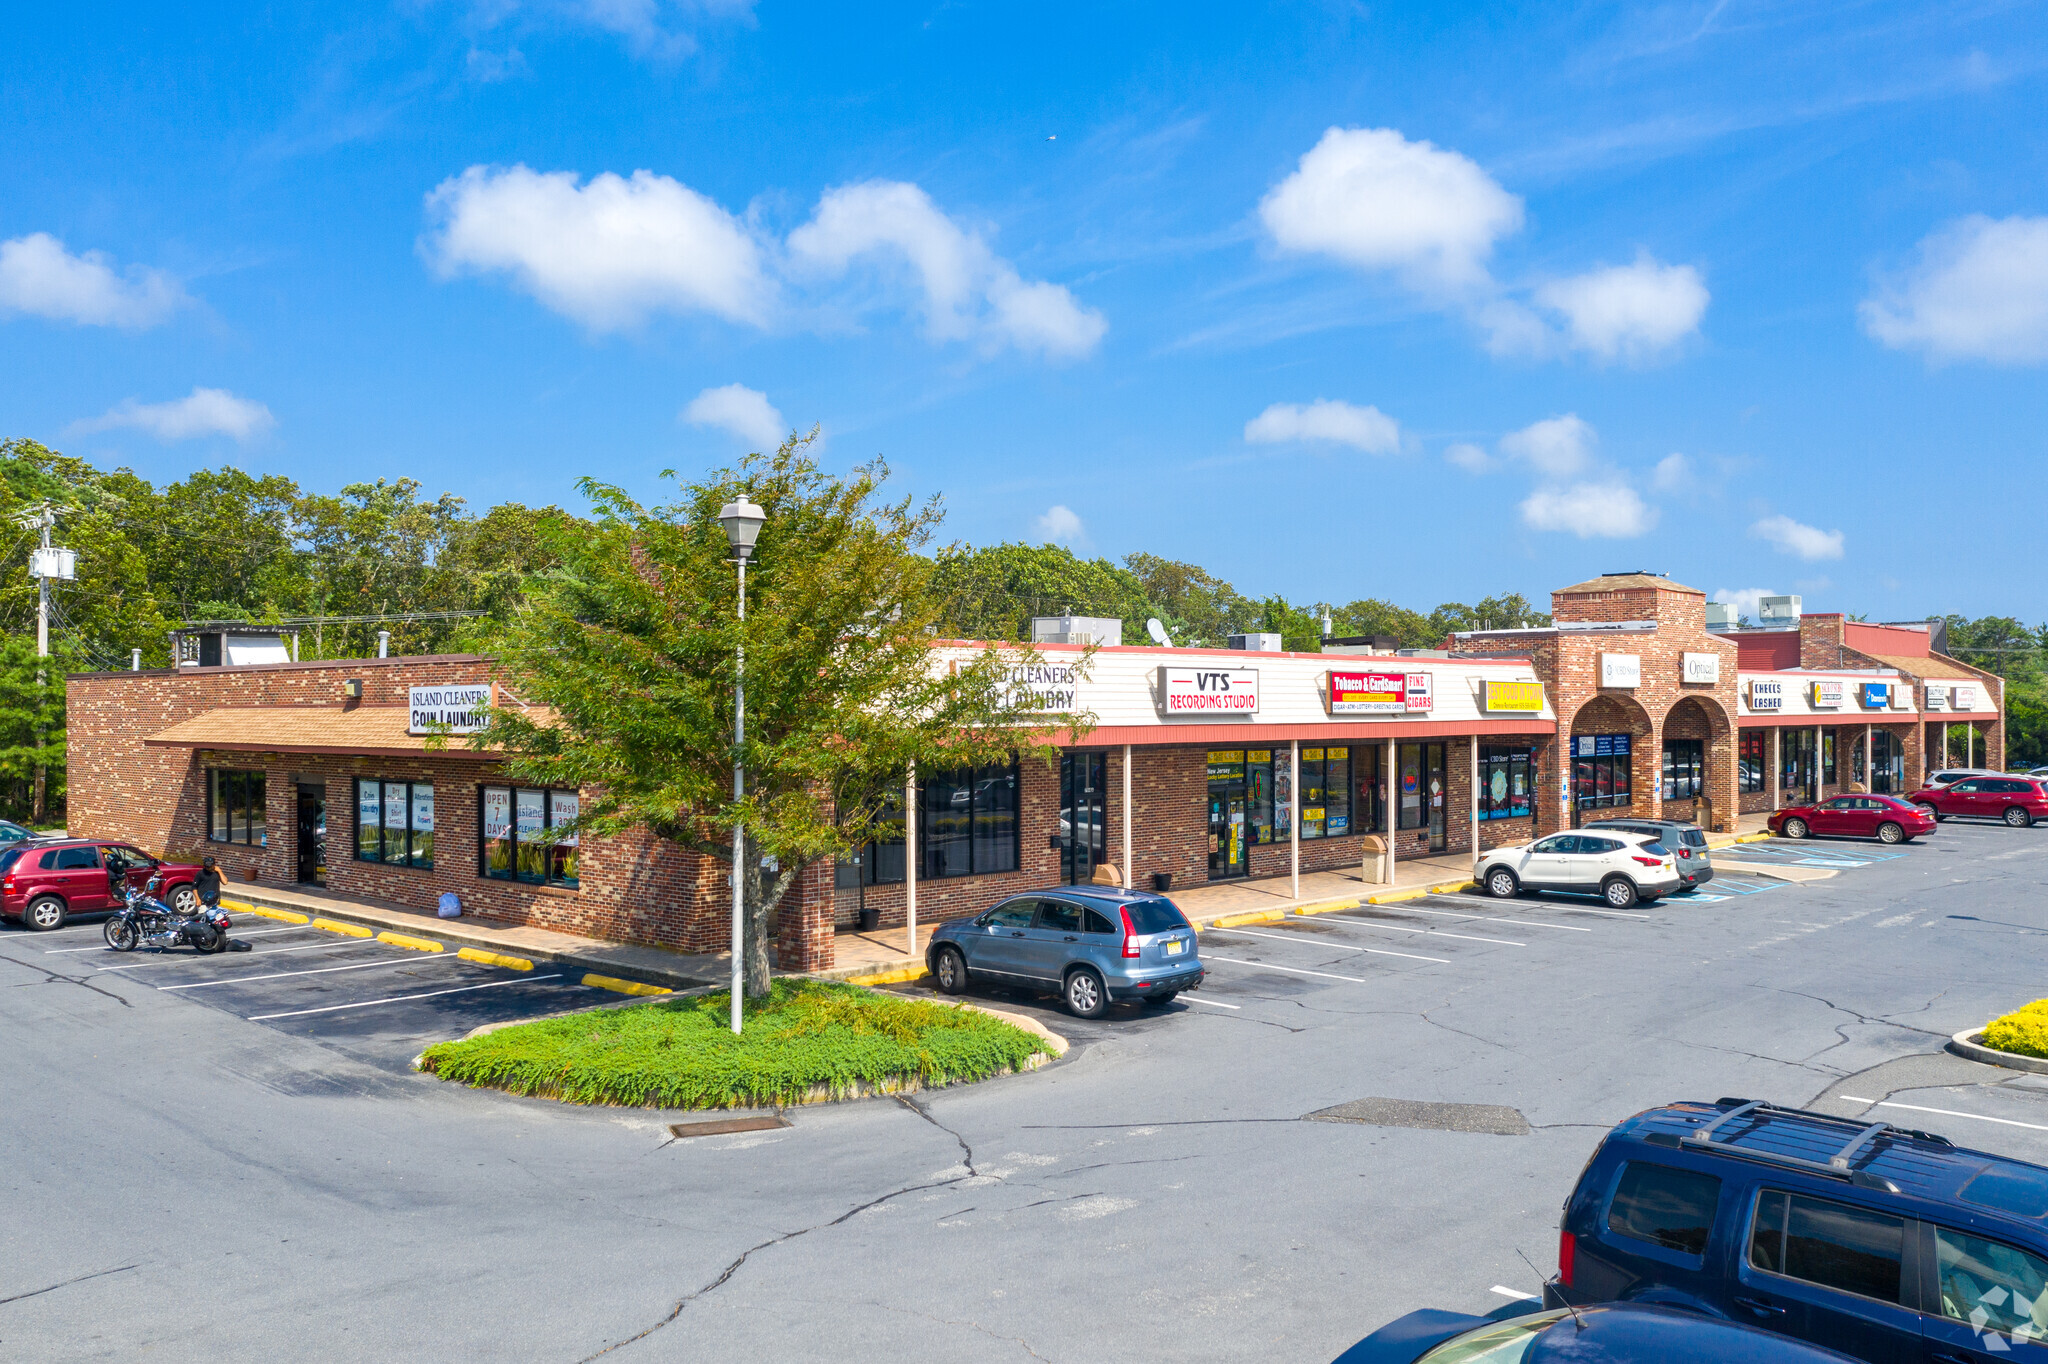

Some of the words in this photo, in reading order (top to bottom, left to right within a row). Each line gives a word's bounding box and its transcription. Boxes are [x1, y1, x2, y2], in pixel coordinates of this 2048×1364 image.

[1013, 667, 1074, 684] CLEANERS
[1689, 660, 1714, 677] Optical
[1197, 673, 1229, 691] VTS
[1334, 677, 1362, 690] Tobacco
[1363, 677, 1368, 691] &
[1409, 676, 1424, 687] FINE
[413, 692, 442, 706] ISLAND
[444, 690, 487, 706] CLEANERS
[1488, 684, 1501, 699] BEST
[1504, 684, 1518, 700] FOOD
[1520, 685, 1525, 700] IN
[1526, 685, 1542, 700] TOWN
[1170, 695, 1221, 710] RECORDING
[1224, 695, 1255, 708] STUDIO
[1408, 697, 1431, 707] CIGARS
[1755, 698, 1782, 708] CASHED
[412, 710, 436, 727] COIN
[487, 793, 508, 804] OPEN
[494, 807, 499, 821] 7
[518, 804, 543, 818] Island
[556, 801, 576, 814] Wash
[487, 824, 507, 836] DAYS
